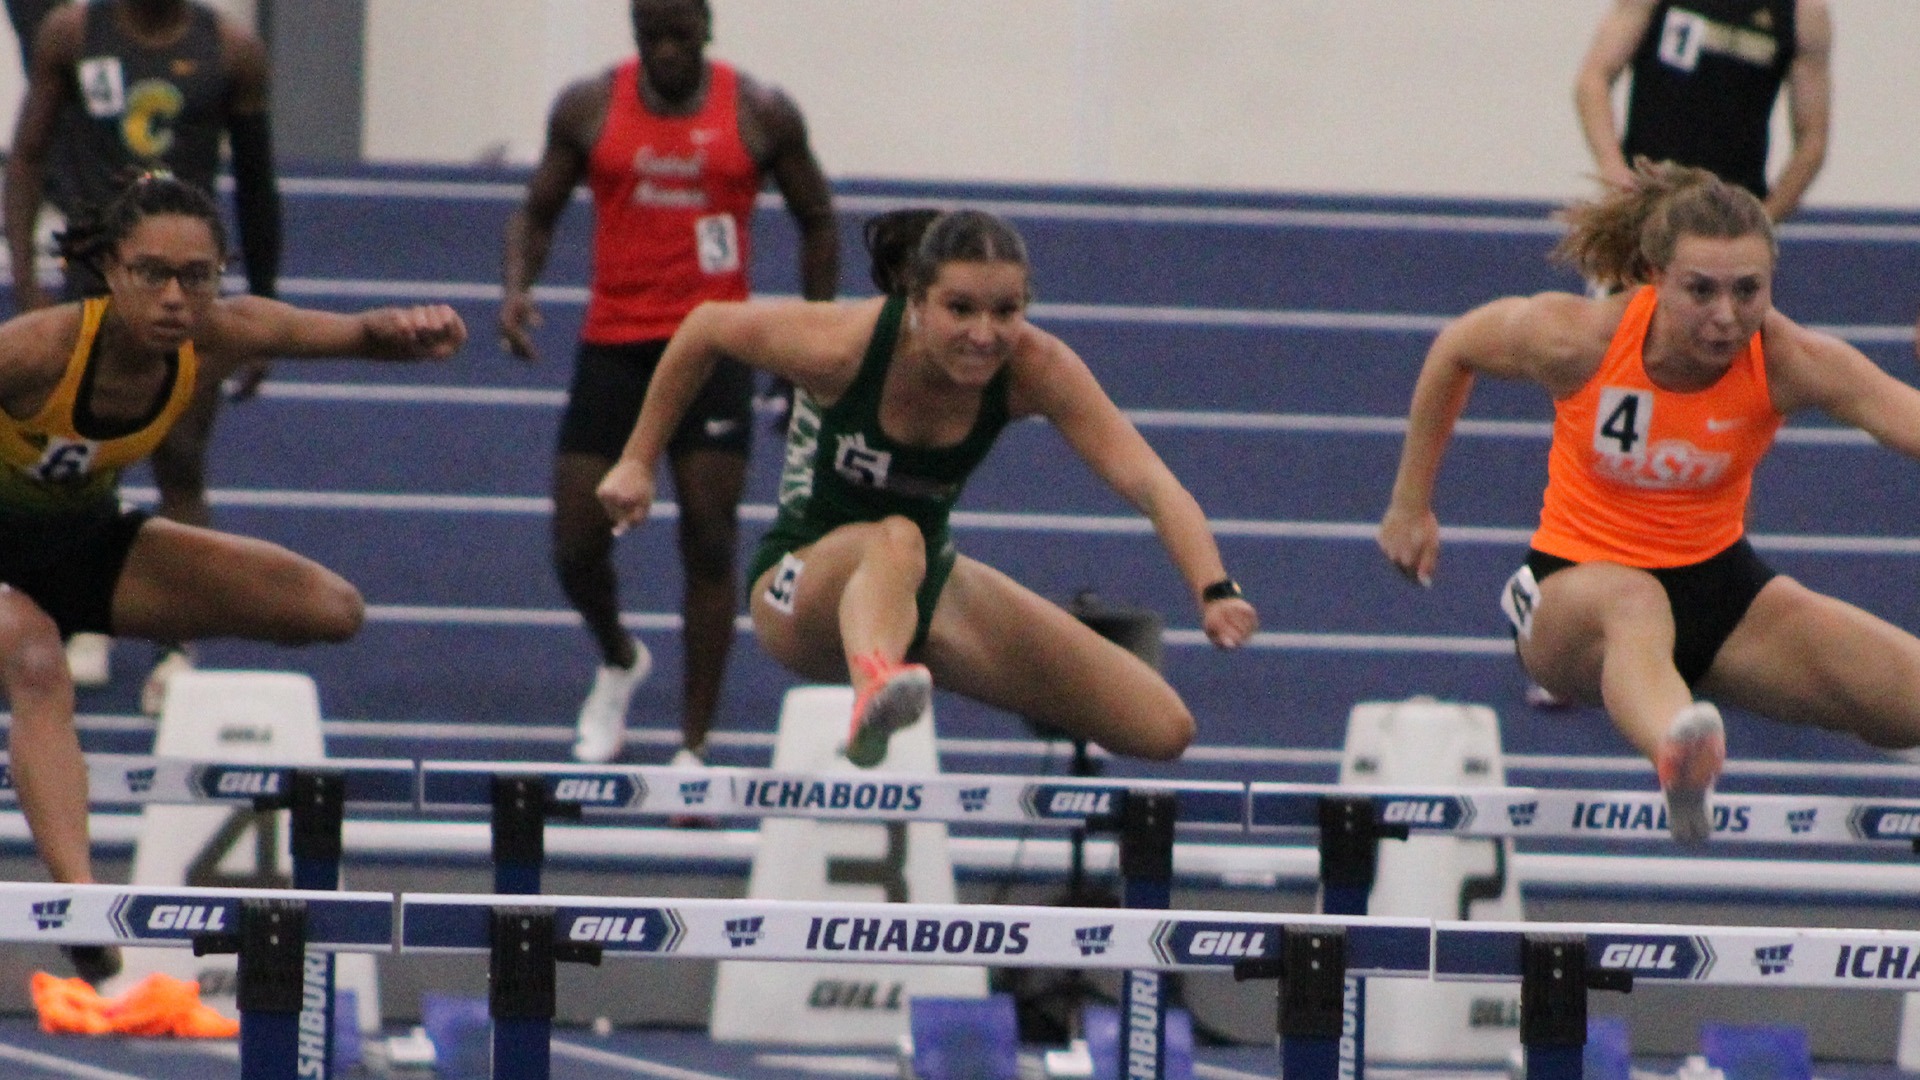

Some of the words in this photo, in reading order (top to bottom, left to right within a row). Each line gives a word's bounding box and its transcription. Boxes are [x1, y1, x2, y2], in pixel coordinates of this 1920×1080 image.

[123, 80, 183, 157] C
[705, 219, 729, 270] 3
[1600, 394, 1639, 454] 4
[41, 445, 88, 479] 6
[843, 447, 878, 483] 5
[1510, 578, 1533, 626] 4
[217, 771, 280, 793] GILL
[555, 779, 619, 801] GILL
[745, 780, 924, 811] ICHABODS
[1050, 792, 1112, 814] GILL
[1383, 801, 1446, 823] GILL
[1571, 802, 1752, 834] ICHADS
[147, 905, 225, 930] GILL
[569, 916, 647, 941] GILL
[806, 917, 1031, 955] ICHABODS
[1188, 930, 1266, 956] GILL
[1600, 943, 1677, 969] GILL
